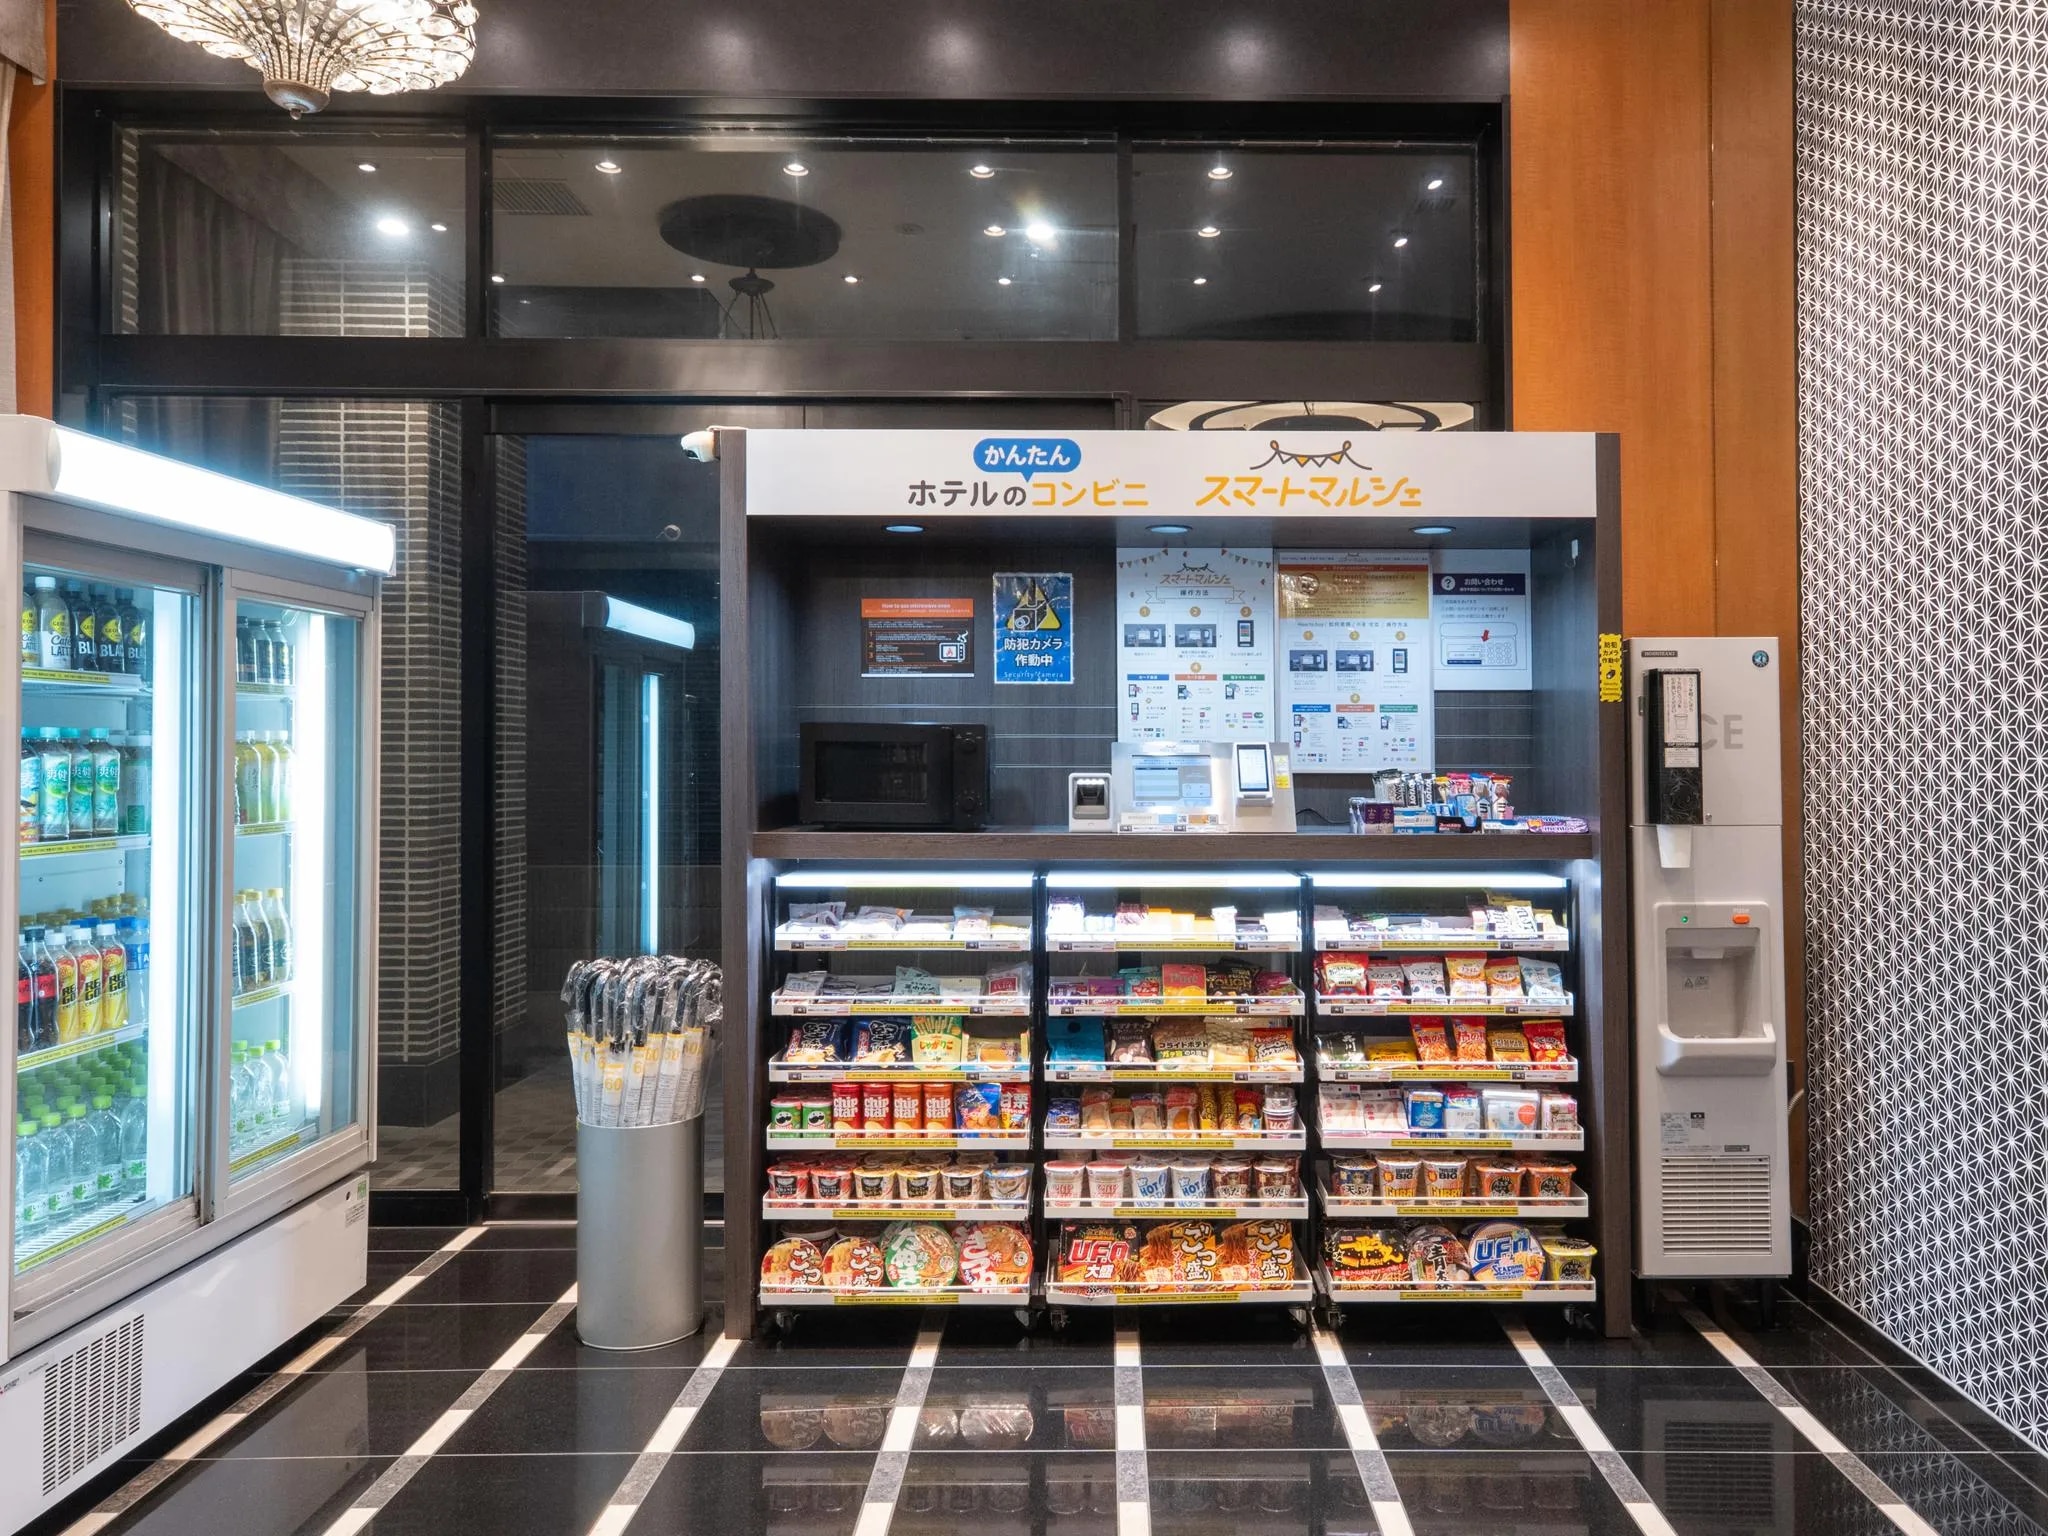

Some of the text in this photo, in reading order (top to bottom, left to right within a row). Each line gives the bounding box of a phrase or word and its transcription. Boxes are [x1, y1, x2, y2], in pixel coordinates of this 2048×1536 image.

[984, 445, 1070, 467] かんたん
[908, 478, 1149, 508] ホテルのコンビニ
[1195, 476, 1422, 508] スマートマルシェ
[1464, 578, 1504, 586] お問い合わせ
[1004, 638, 1063, 650] 防犯カメラ
[51, 646, 70, 656] LATT
[1015, 654, 1054, 667] 作動中
[1701, 714, 1744, 750] CE
[833, 1096, 858, 1109] chip
[864, 1096, 889, 1109] chip
[894, 1096, 918, 1109] chip
[926, 1096, 950, 1109] chip
[833, 1106, 858, 1118] star
[864, 1106, 889, 1118] star
[894, 1106, 918, 1118] star
[926, 1106, 950, 1118] star
[1269, 1121, 1290, 1129] UCC
[1140, 1184, 1159, 1197] HOT
[1182, 1184, 1200, 1197] HOT
[1180, 1222, 1217, 1282] ごつ盛り
[1256, 1222, 1293, 1282] ごつ盛り
[790, 1246, 822, 1292] ごつ盛
[850, 1246, 882, 1290] ごつ盛
[1086, 1264, 1114, 1279] 大盛
